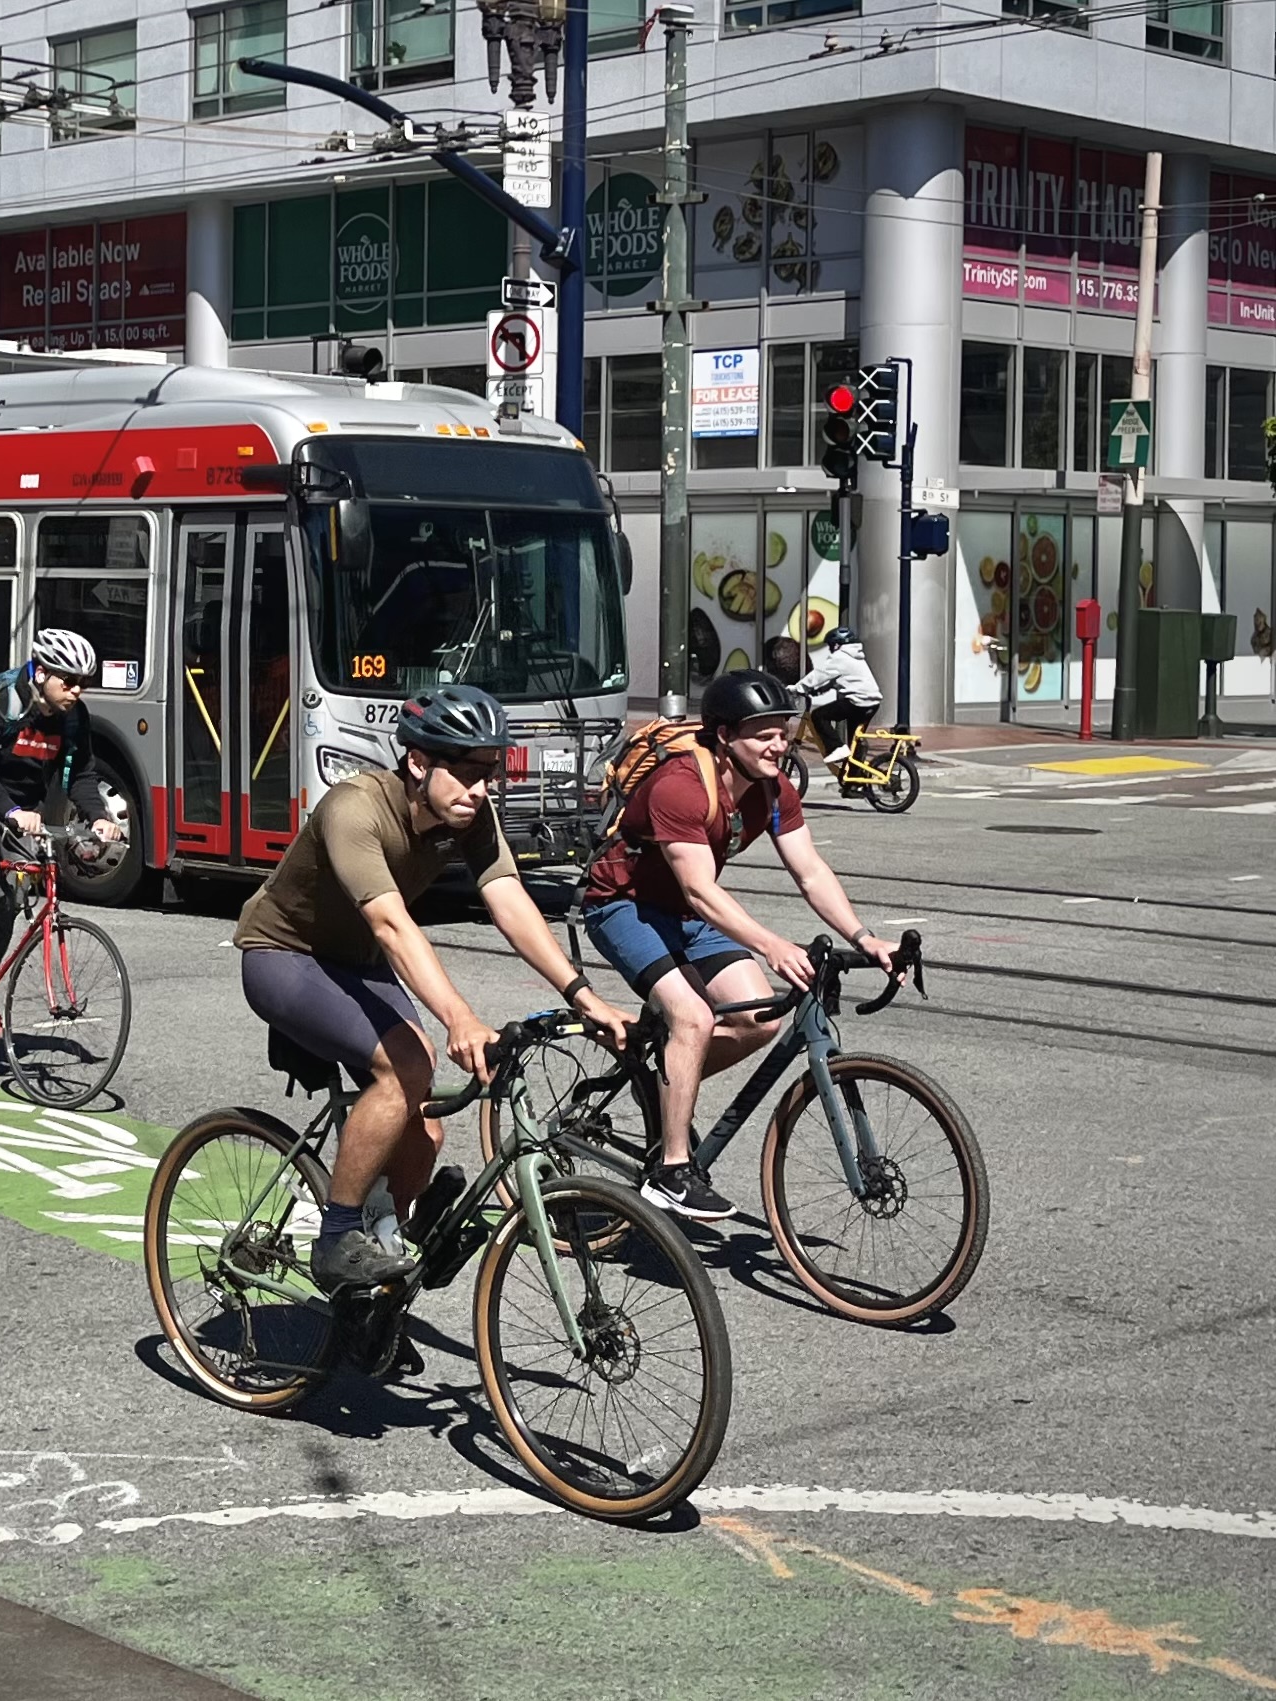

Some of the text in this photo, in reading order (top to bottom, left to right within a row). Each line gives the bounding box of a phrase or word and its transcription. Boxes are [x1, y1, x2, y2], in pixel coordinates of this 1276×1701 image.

[517, 117, 538, 130] NO
[586, 206, 661, 259] WHOLE FOODS
[14, 240, 140, 274] Avalable Now
[337, 242, 390, 283] WHOLE FOODS
[597, 259, 647, 273] MARKET
[963, 263, 1048, 291] TrinitySFcom
[23, 280, 71, 308] Reail
[344, 283, 382, 293] MARKET
[70, 330, 85, 348] Up
[142, 323, 170, 342] sq.ft.
[712, 353, 743, 369] TCP
[496, 384, 533, 397] EXCEPT
[695, 387, 759, 403] FOR LEASE
[206, 466, 244, 486] 8726
[351, 655, 386, 678] 169
[365, 704, 399, 724] 872
